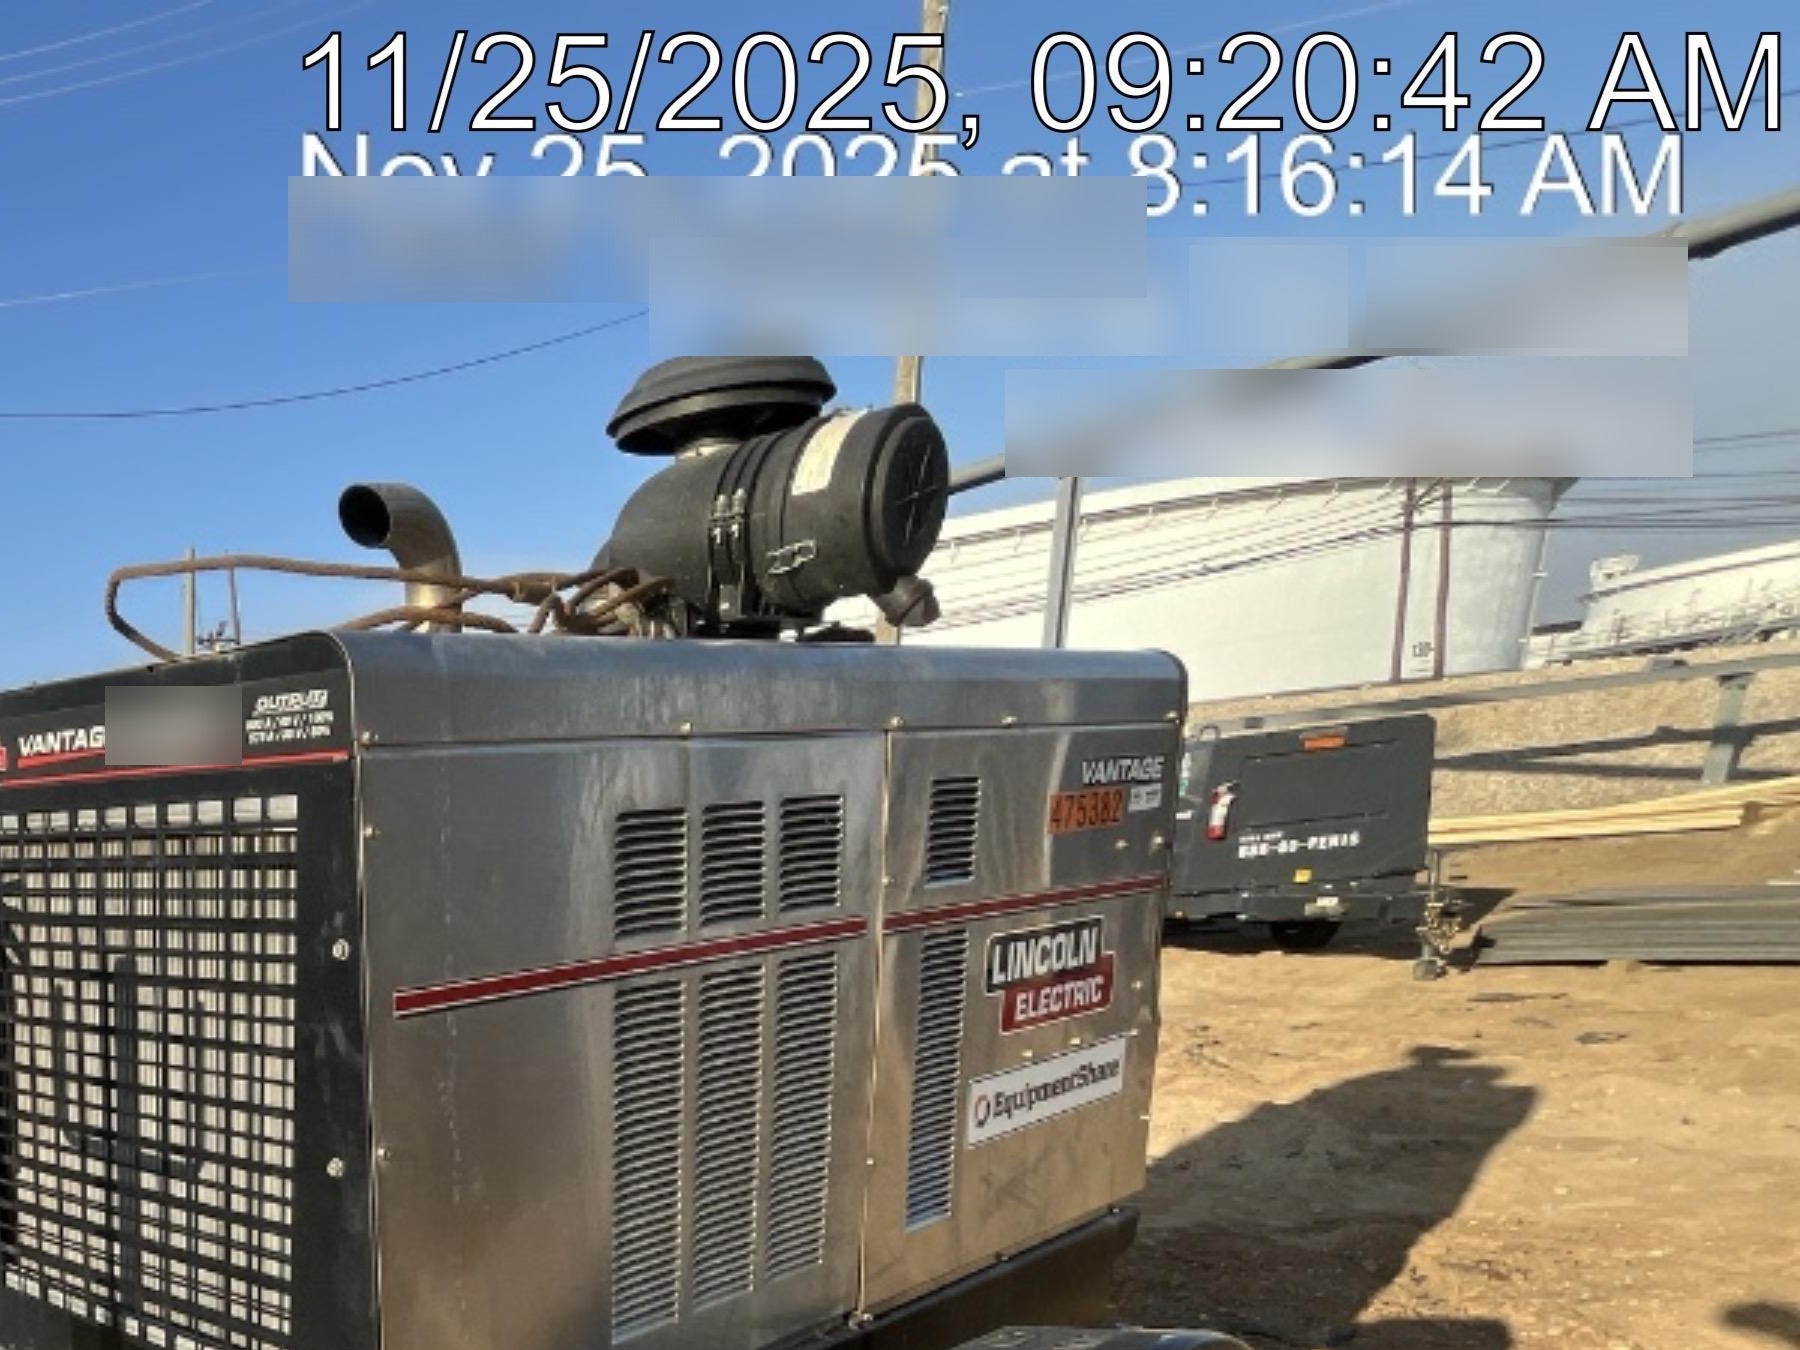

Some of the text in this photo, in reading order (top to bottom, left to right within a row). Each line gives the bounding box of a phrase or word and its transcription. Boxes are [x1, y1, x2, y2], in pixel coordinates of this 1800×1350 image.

[1081, 755, 1166, 785] VANTAGE
[991, 926, 1100, 985] LINCOLN
[1015, 975, 1105, 1021] ELECTRIC
[993, 1058, 1121, 1120] EquipmentShare
